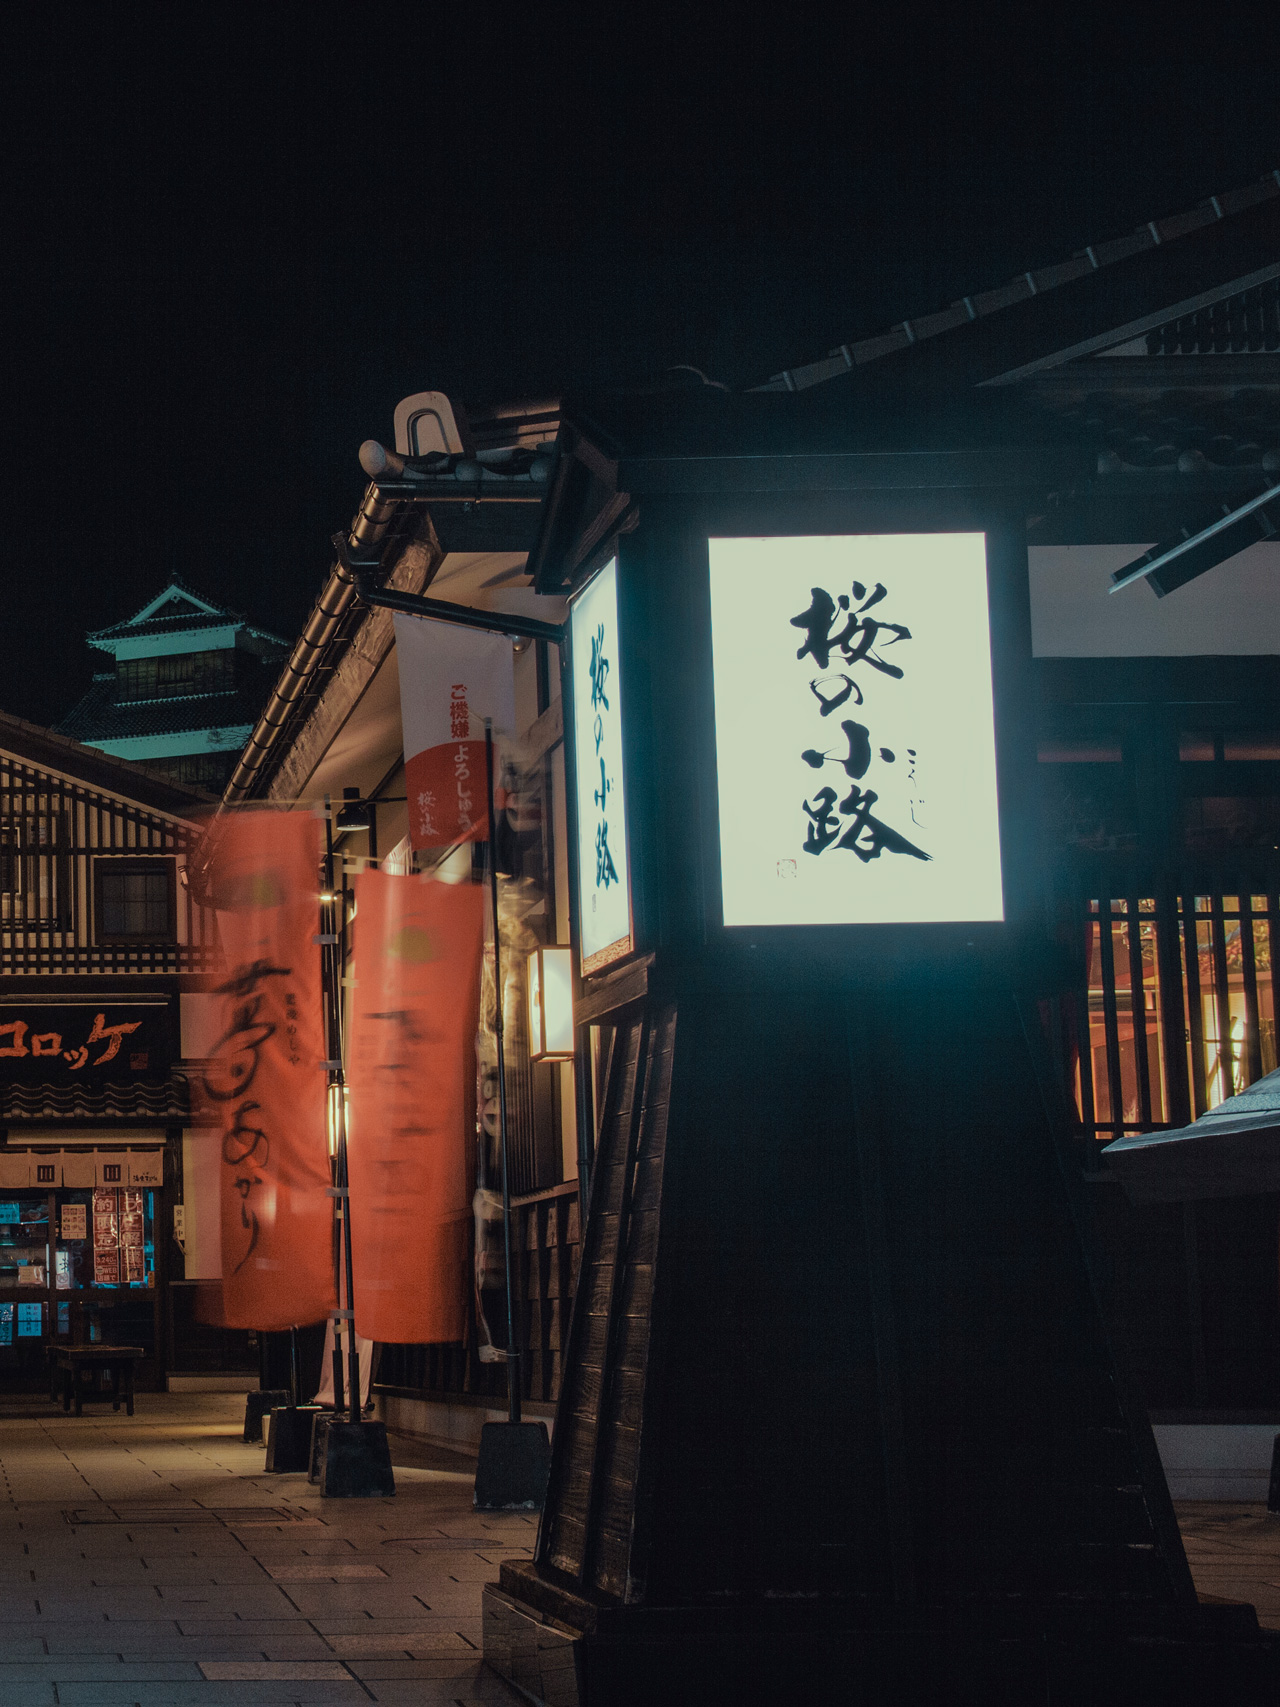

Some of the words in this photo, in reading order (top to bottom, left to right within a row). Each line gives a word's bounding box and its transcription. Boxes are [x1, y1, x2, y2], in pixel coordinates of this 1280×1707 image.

[589, 622, 619, 890] 桜の小路
[790, 581, 934, 863] 桜の小路
